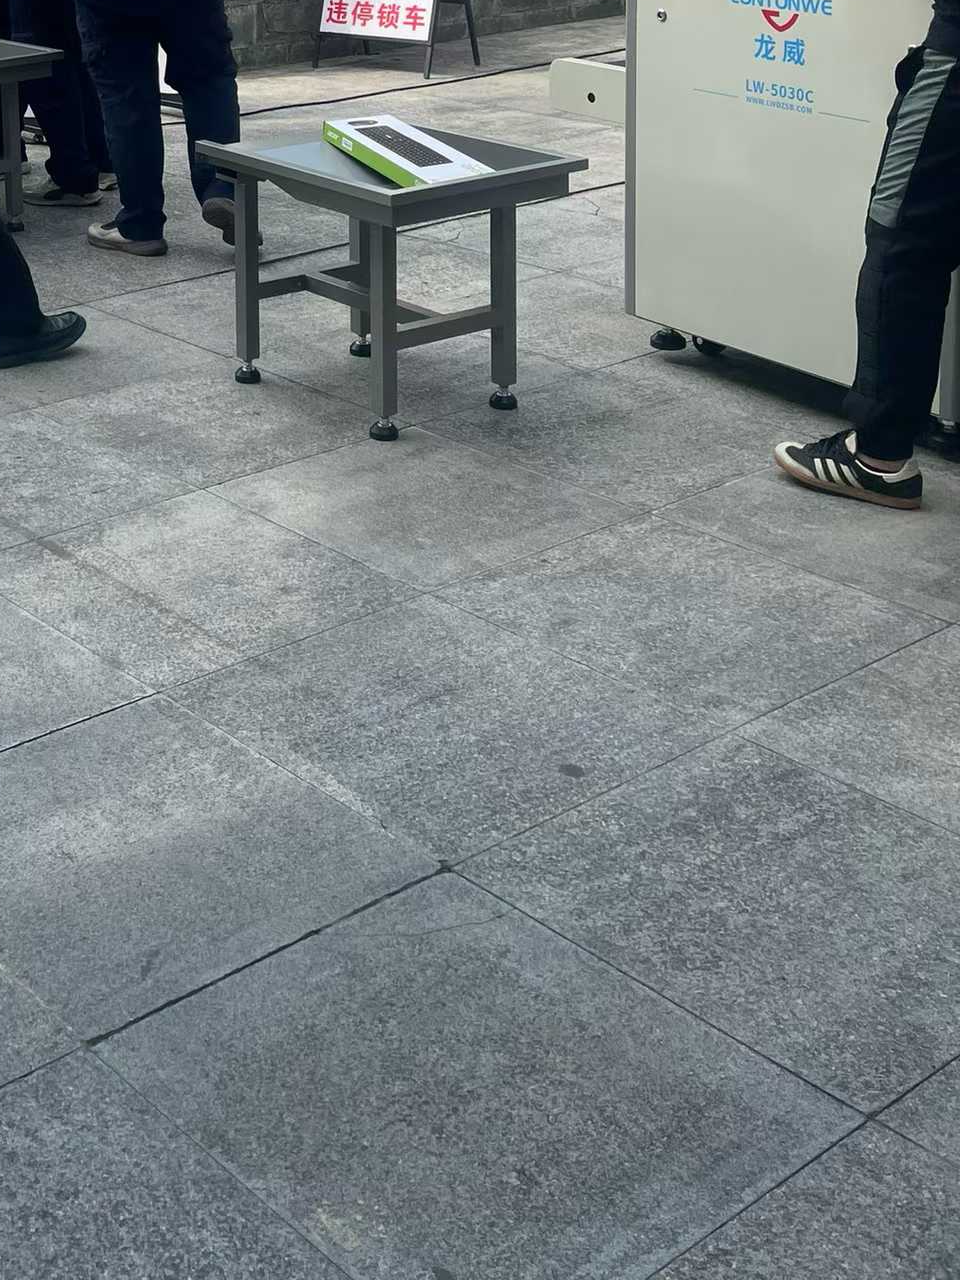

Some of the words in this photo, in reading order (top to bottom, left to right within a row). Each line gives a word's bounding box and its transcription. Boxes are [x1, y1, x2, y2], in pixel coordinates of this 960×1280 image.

[326, 0, 426, 31] 违停锁车
[754, 33, 805, 65] 龙威
[745, 79, 814, 103] LW-5030C
